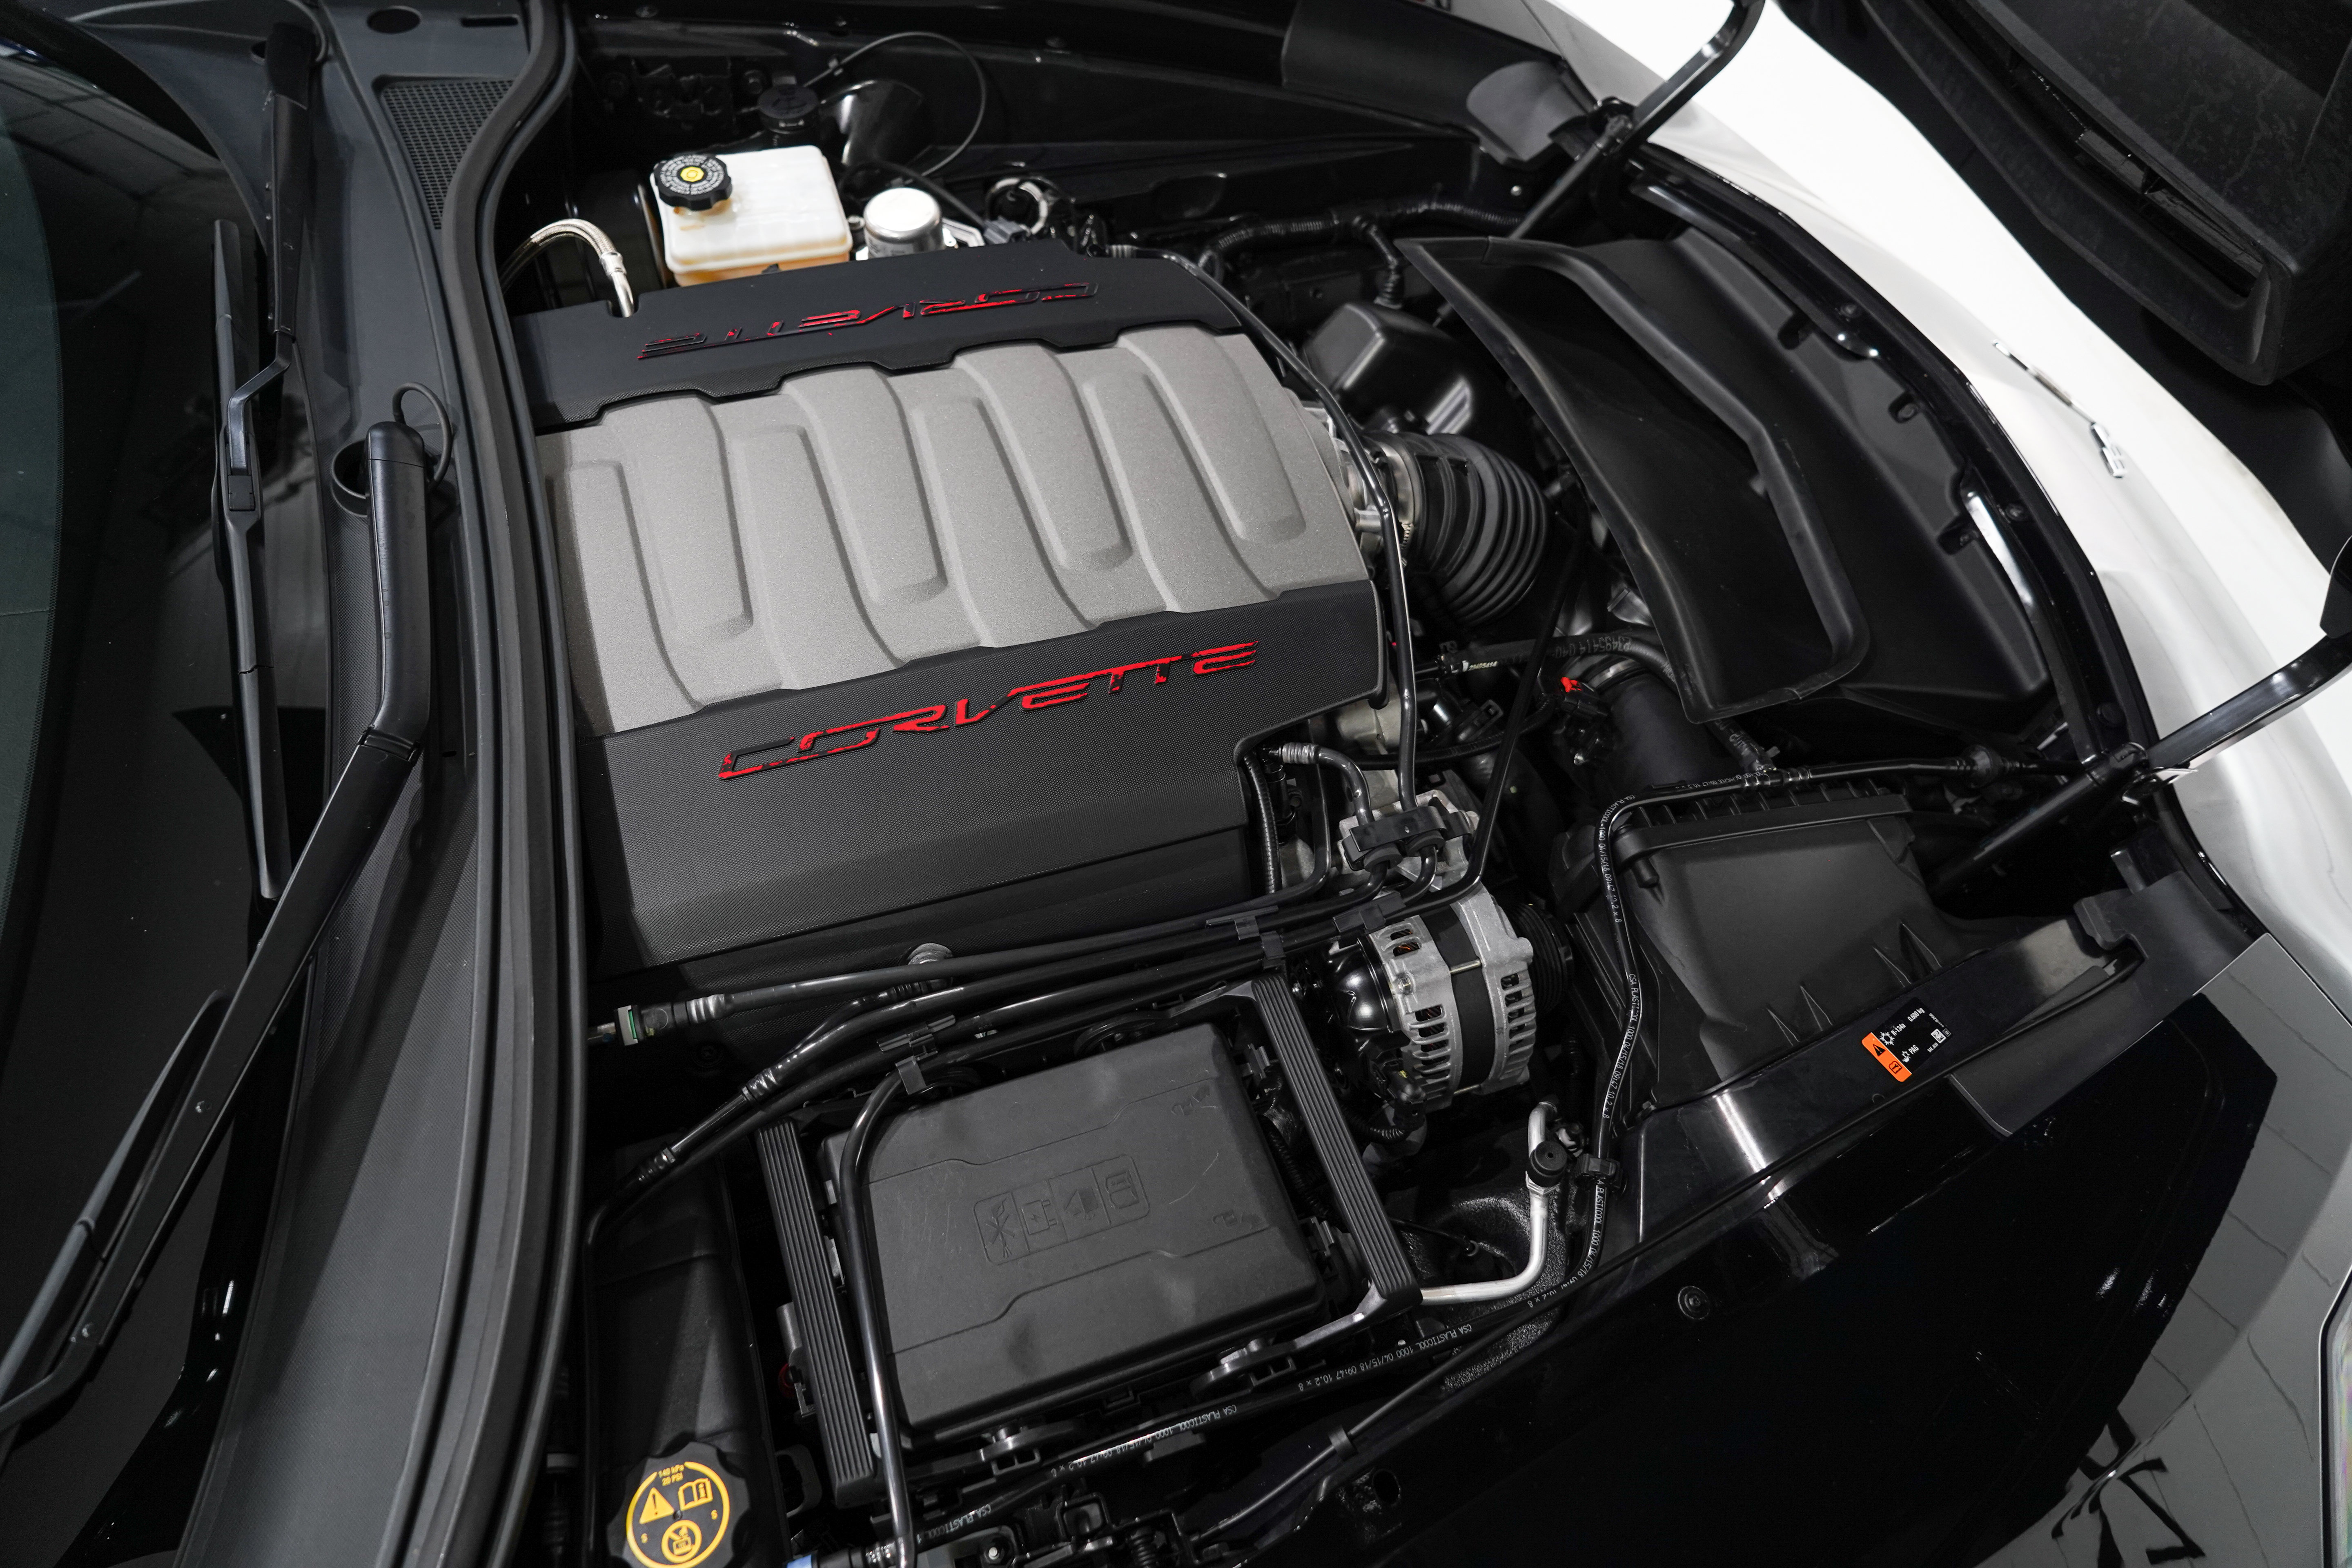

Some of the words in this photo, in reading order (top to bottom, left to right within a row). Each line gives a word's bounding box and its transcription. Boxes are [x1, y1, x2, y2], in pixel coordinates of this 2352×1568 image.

[718, 640, 1258, 780] CORVETTE
[1598, 843, 1610, 871] 04/15/18
[1628, 973, 1637, 985] CSA
[1907, 1011, 1920, 1022] 0.600
[1626, 1026, 1635, 1040] 1000
[1891, 1023, 1907, 1036] R-134a
[1616, 1041, 1631, 1069] 04/15/18
[1908, 1045, 1919, 1055] PAG
[1610, 1070, 1621, 1089] 09:47
[1607, 1091, 1615, 1105] 10.2
[1595, 1187, 1605, 1225] PLASTICOOL
[1591, 1229, 1601, 1246] 1000
[1577, 1247, 1597, 1278] 04/15/18
[1457, 1324, 1472, 1334] CSA
[1415, 1329, 1457, 1350] PLASTICOOL
[1396, 1345, 1413, 1358] 1000
[1359, 1352, 1393, 1372] 04/15/18
[1336, 1365, 1357, 1380] 09:47
[1298, 1382, 1304, 1392] 8
[1314, 1374, 1332, 1386] 10.2
[1222, 1404, 1237, 1415] CSA
[1176, 1410, 1221, 1431] PLASTICOOL
[1154, 1427, 1173, 1439] 1000
